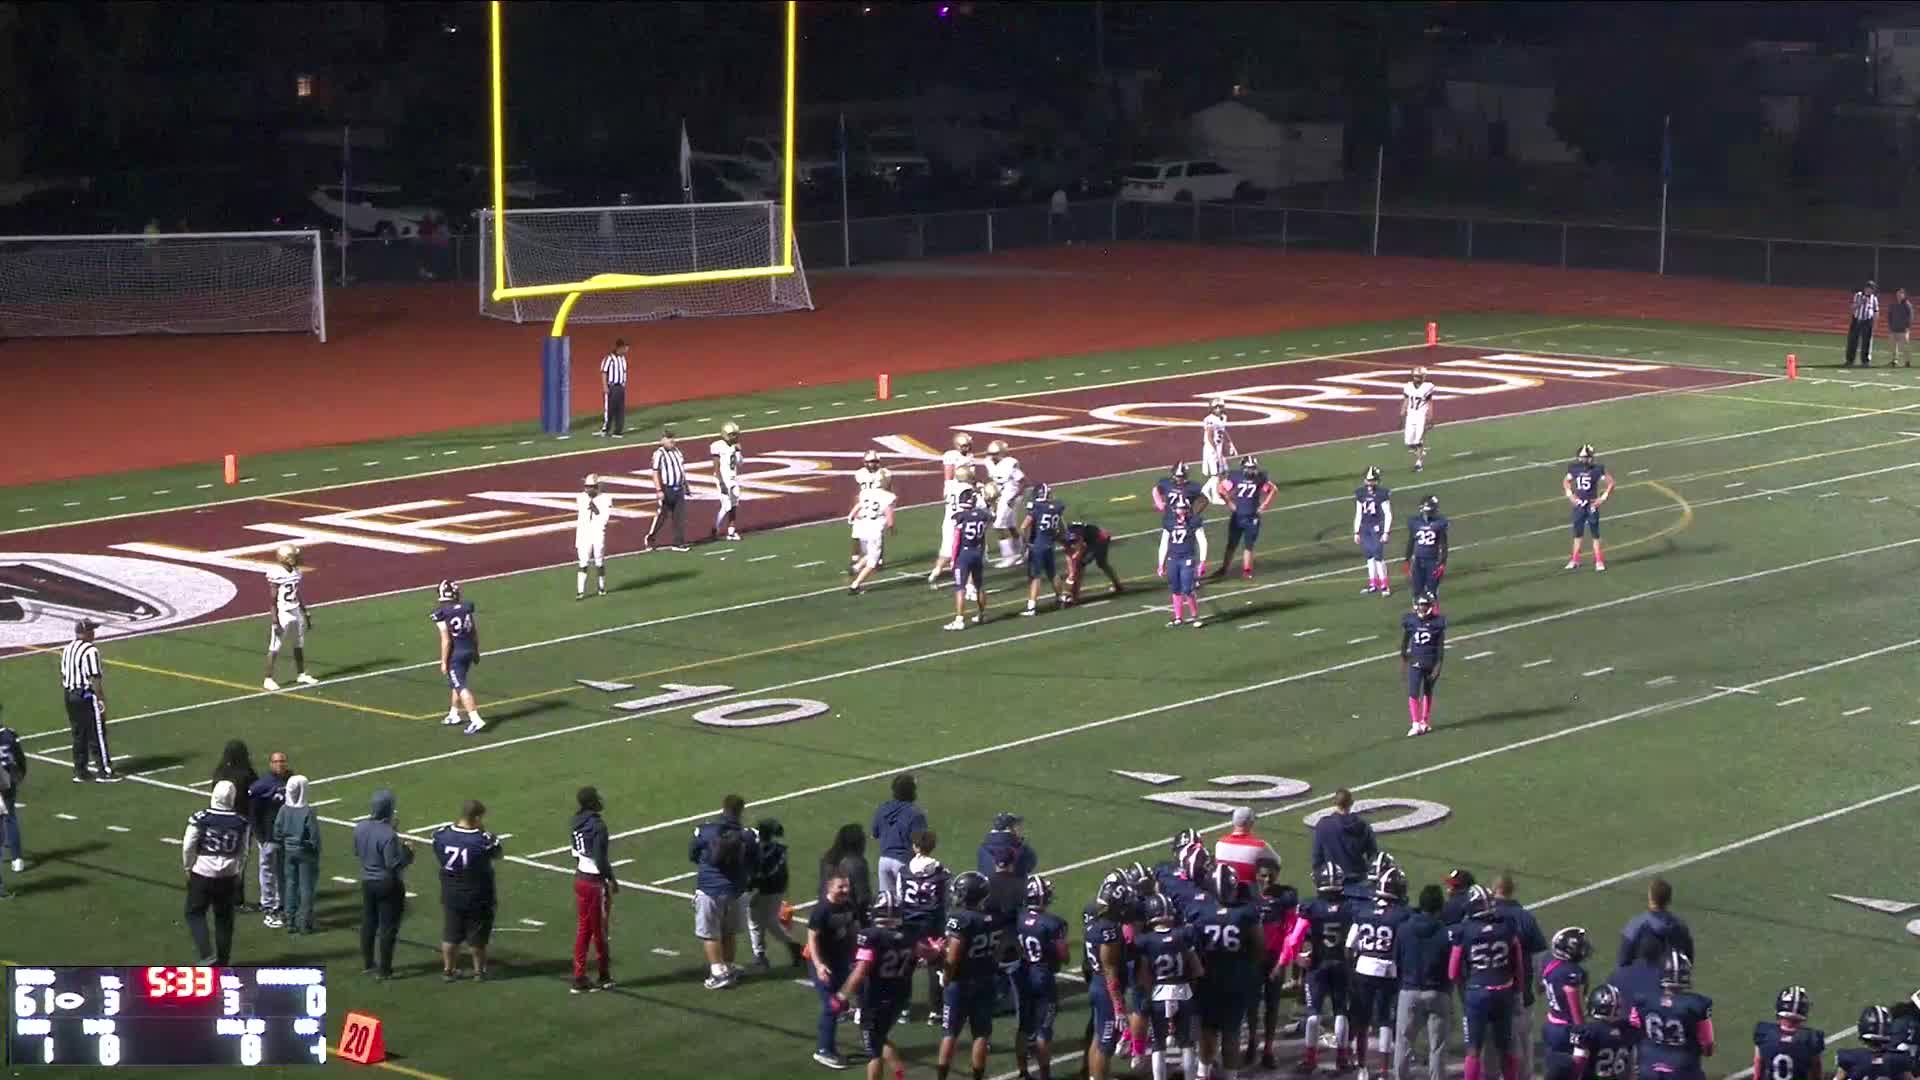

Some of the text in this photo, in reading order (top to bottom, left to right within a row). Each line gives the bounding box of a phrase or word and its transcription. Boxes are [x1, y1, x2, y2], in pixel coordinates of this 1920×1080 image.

[949, 368, 1545, 446] FORD
[1409, 396, 1422, 410] 17
[1237, 483, 1257, 498] 77
[1576, 476, 1592, 490] 15
[1361, 500, 1376, 515] 14
[965, 521, 986, 540] 50
[1171, 529, 1187, 544] 17
[1415, 530, 1436, 546] 32
[450, 614, 472, 637] 34
[612, 683, 831, 728] 10
[1140, 774, 1452, 833] 20
[444, 845, 469, 871] 71
[1204, 925, 1240, 951] 76
[1323, 922, 1341, 947] 5
[1471, 942, 1509, 970] 52
[345, 1023, 370, 1058] 20
[1645, 1012, 1686, 1046] 63
[1596, 1048, 1630, 1077] 26
